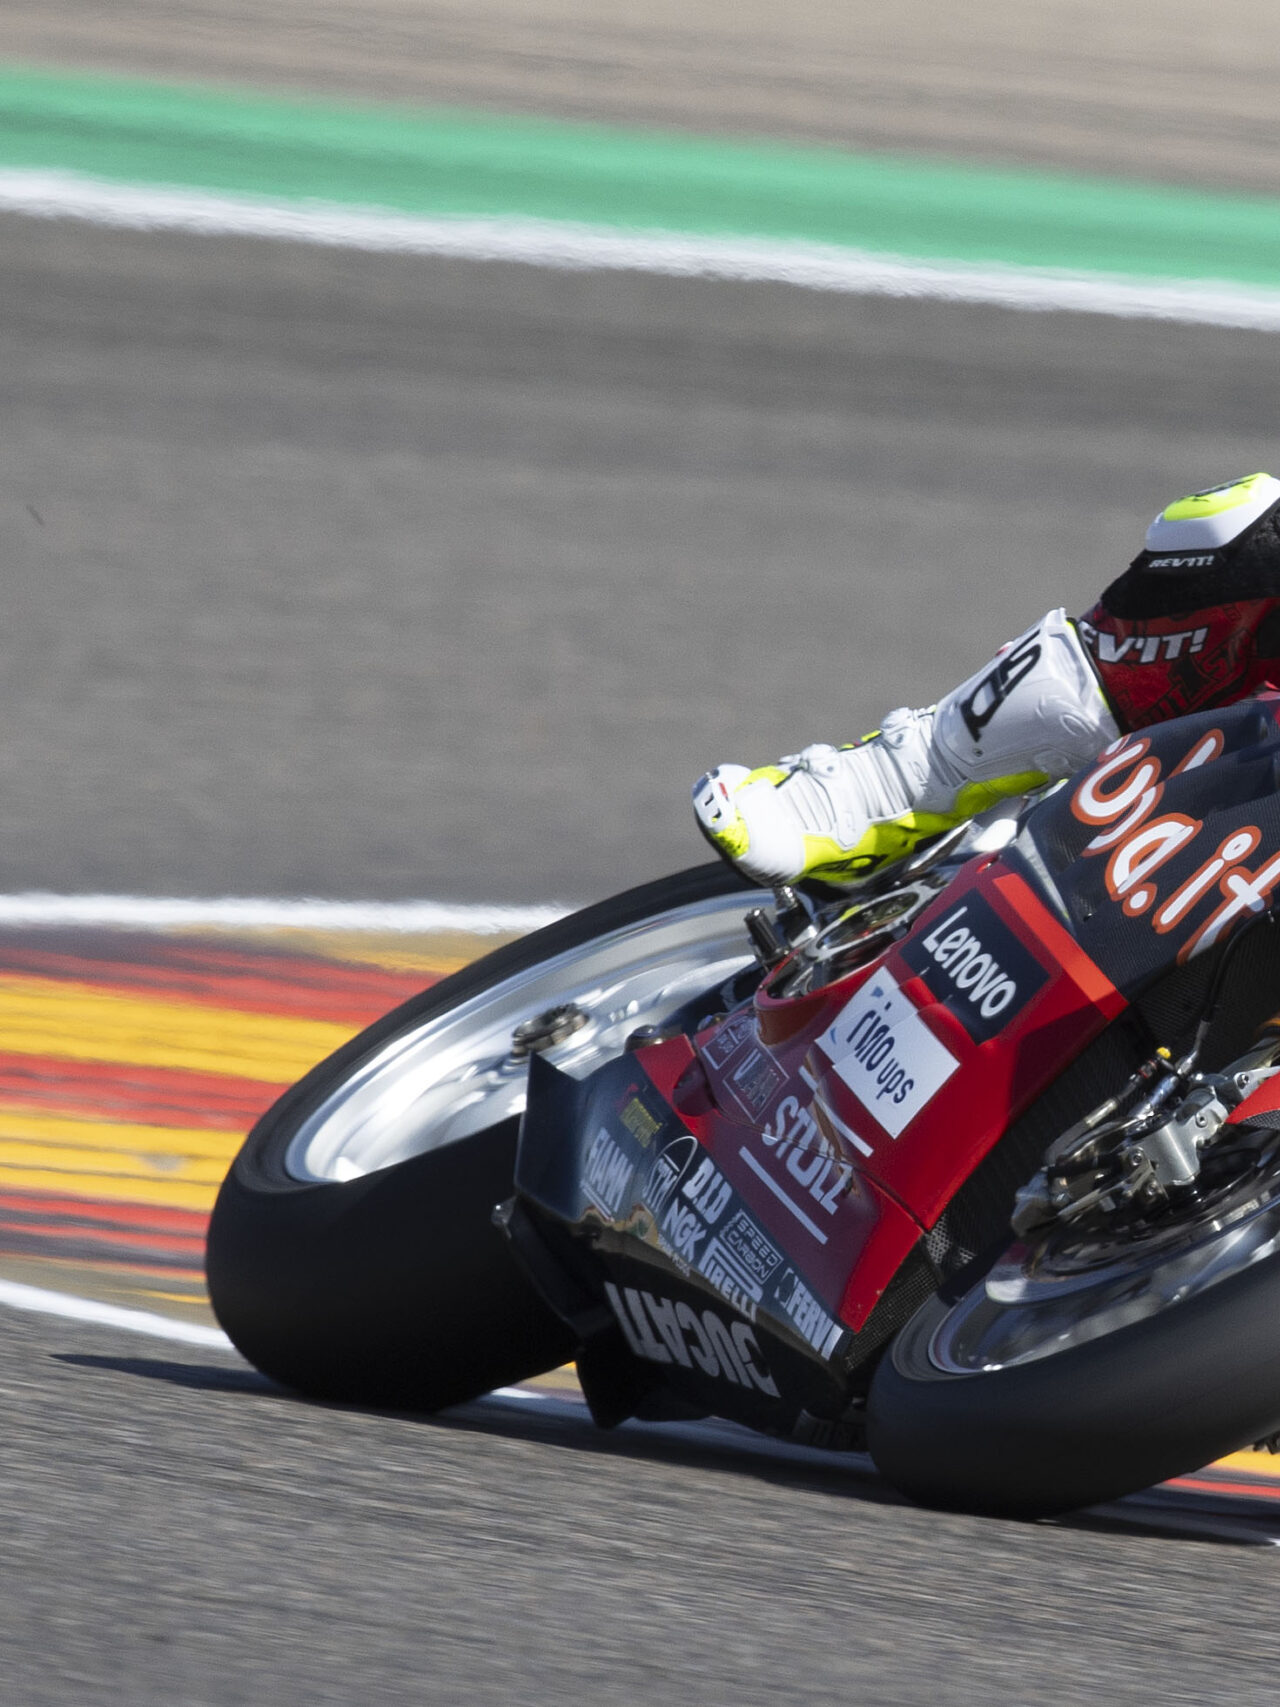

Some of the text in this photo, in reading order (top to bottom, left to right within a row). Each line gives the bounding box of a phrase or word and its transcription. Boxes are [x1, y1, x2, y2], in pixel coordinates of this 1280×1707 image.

[921, 905, 1018, 1019] Lenovo
[875, 1057, 915, 1104] ups
[762, 1095, 855, 1215] STULZ
[661, 1198, 708, 1261] NGK
[725, 1230, 771, 1281] CARBON
[735, 1219, 780, 1267] SPEED
[698, 1236, 764, 1322] PIRELLI
[784, 1279, 844, 1361] FERVI
[604, 1281, 781, 1398] DUCATI
